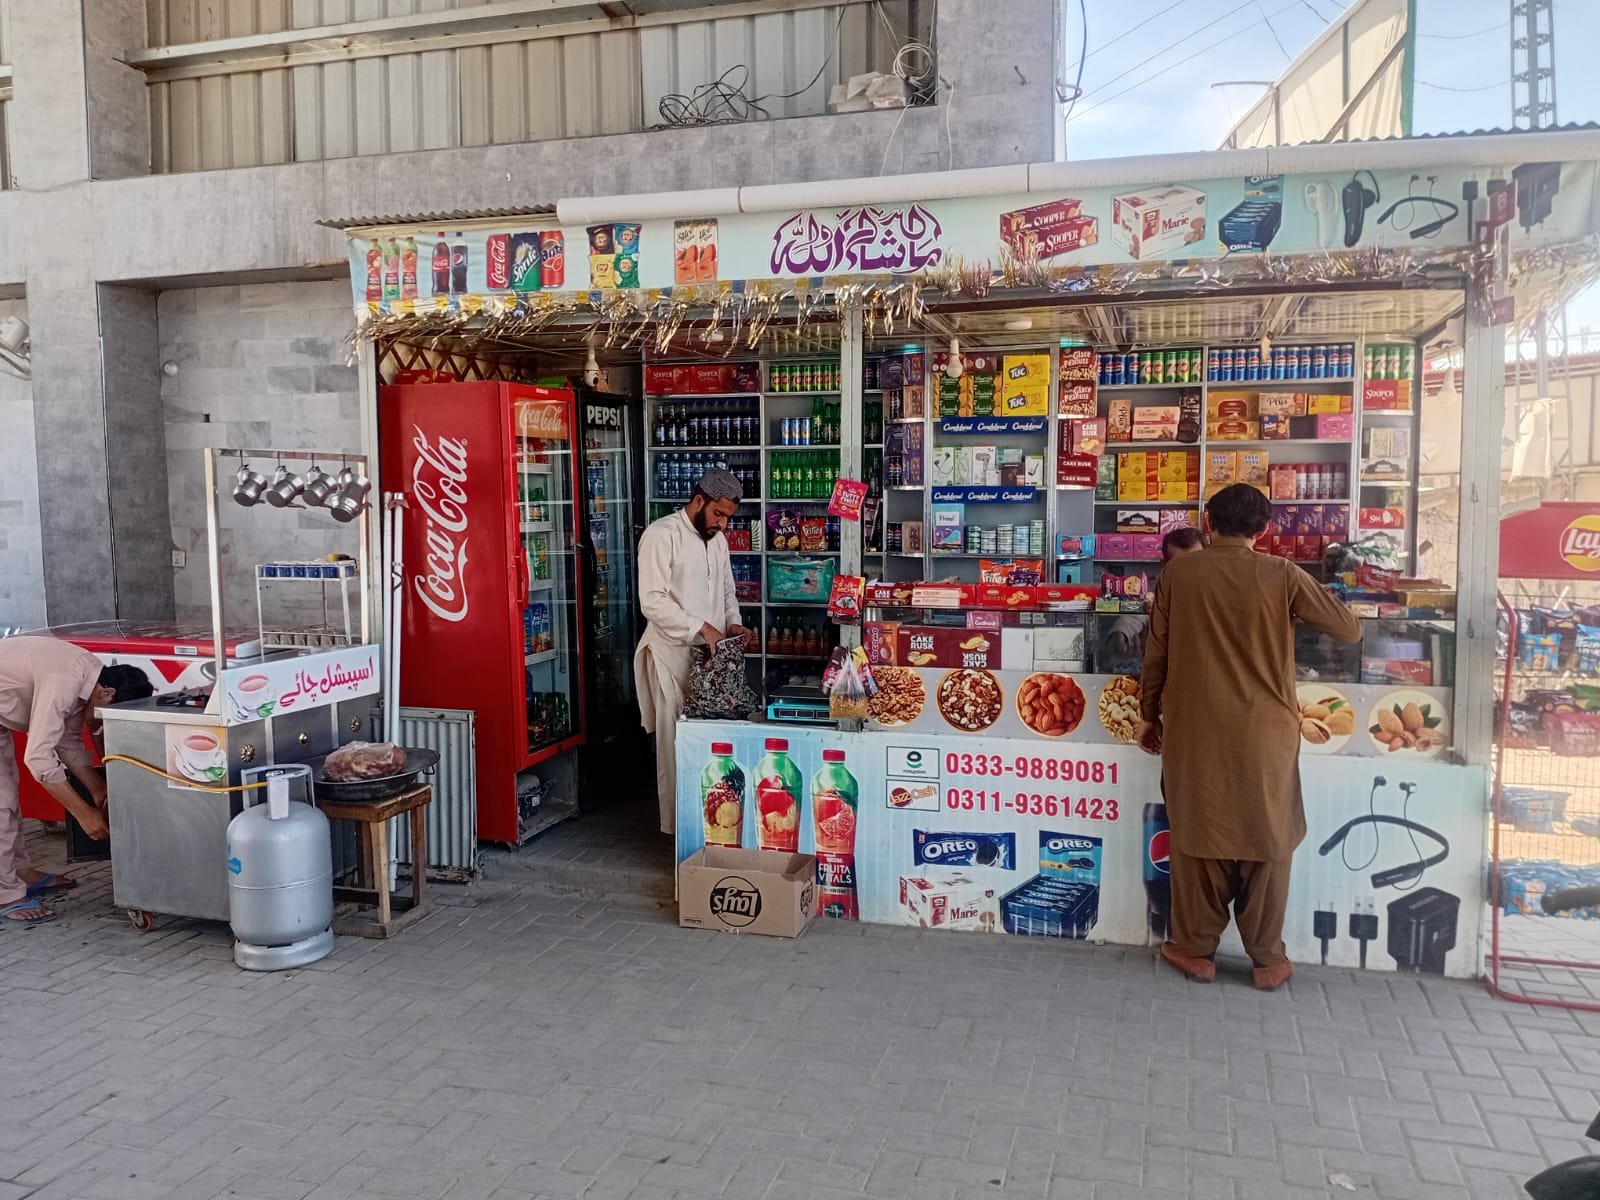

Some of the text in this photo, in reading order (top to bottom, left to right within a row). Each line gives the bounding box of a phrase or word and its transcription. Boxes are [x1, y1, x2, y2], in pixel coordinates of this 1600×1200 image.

[1034, 211, 1066, 227] SOOPER
[1161, 215, 1190, 233] Marie
[1046, 229, 1079, 252] SOOPER
[512, 248, 538, 284] Sprite
[1073, 351, 1091, 360] Glace
[1064, 359, 1089, 368] Peanuts
[1010, 367, 1026, 377] TUC
[1074, 387, 1092, 395] Glace
[1366, 390, 1394, 400] SOOPER
[1009, 397, 1025, 408] TUC
[1064, 394, 1089, 402] Peanuts
[586, 405, 620, 426] PEPSI
[413, 424, 469, 622] Coca-Cola
[910, 635, 934, 644] CAKE
[910, 642, 935, 650] RUSK
[962, 653, 987, 661] RUSK
[962, 659, 987, 668] CAKE
[279, 671, 318, 707] چائے
[945, 752, 1118, 784] 0333-9889081
[946, 788, 1119, 821] 0311-9361423
[923, 840, 976, 858] OREO
[1048, 839, 1092, 849] OREO
[818, 863, 851, 874] FRUITA
[818, 872, 852, 884] VITALS
[950, 907, 978, 921] Marie
